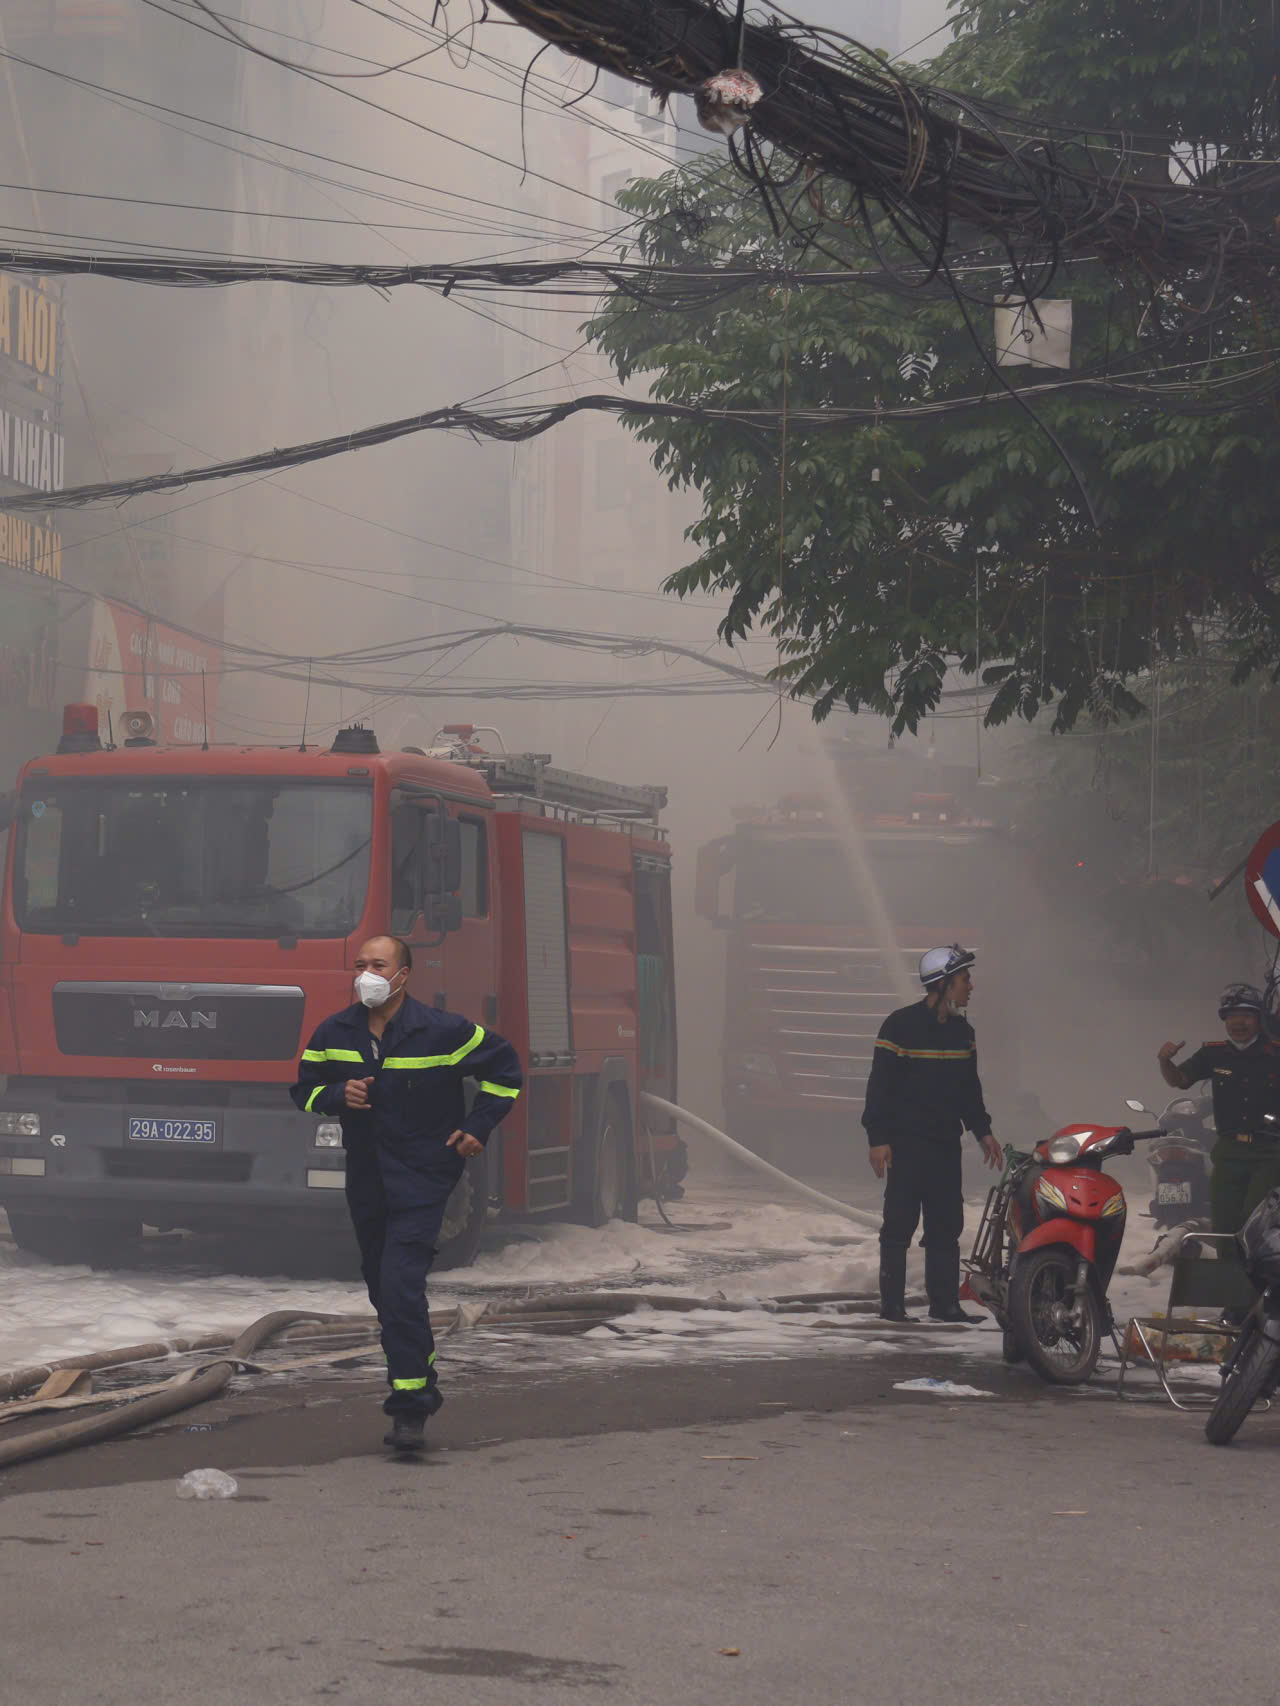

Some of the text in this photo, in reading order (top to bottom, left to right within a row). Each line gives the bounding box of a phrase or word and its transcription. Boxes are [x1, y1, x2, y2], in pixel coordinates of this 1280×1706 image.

[33, 512, 62, 582] DÂN
[133, 1009, 217, 1029] MAN
[131, 1120, 213, 1141] 29A-022.35
